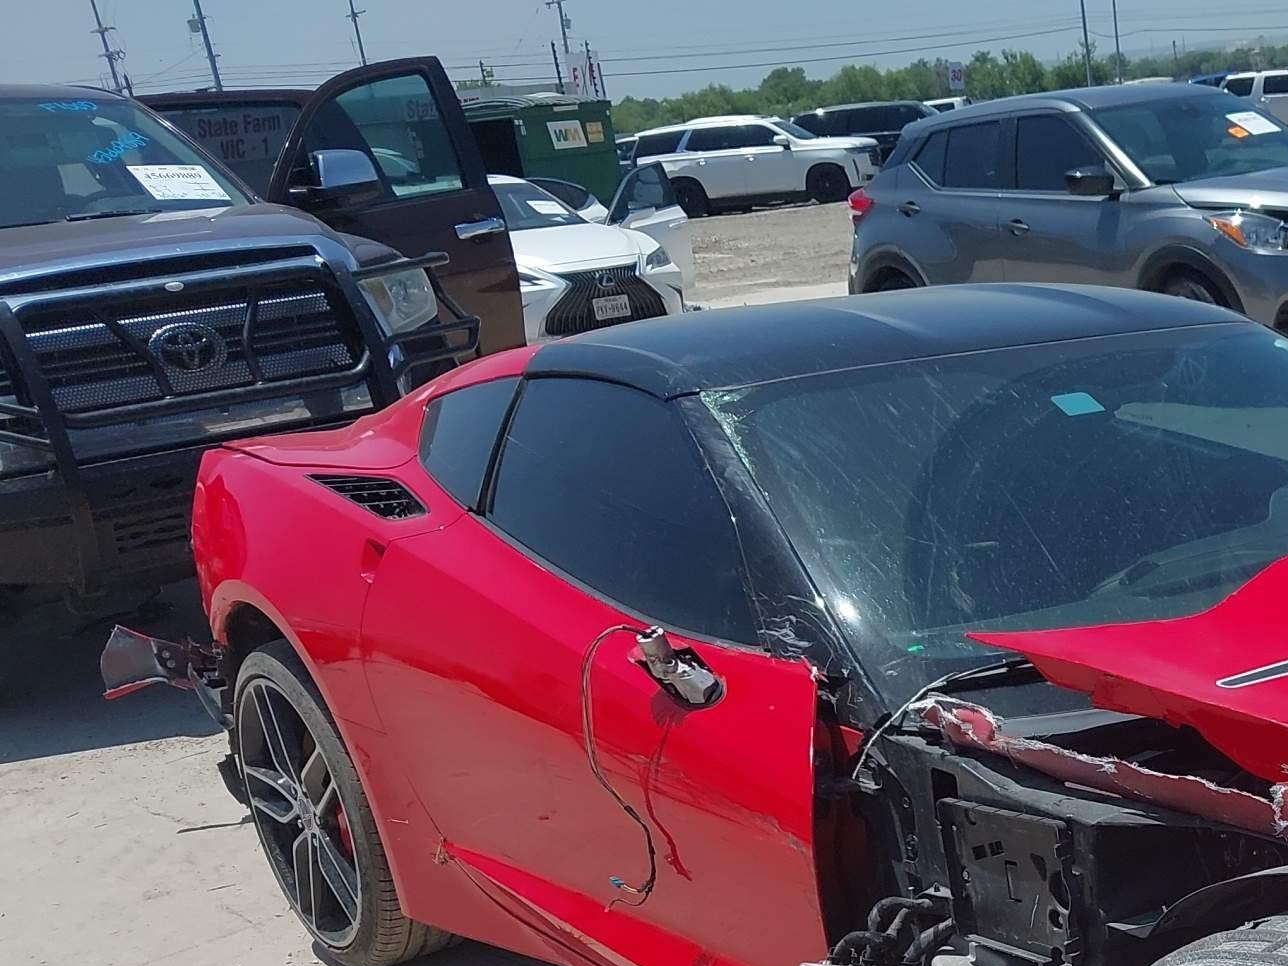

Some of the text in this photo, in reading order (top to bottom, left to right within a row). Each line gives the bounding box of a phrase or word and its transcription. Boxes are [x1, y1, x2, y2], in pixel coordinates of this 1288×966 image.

[198, 113, 282, 138] State Farm
[220, 138, 246, 161] VIC
[262, 138, 269, 155] 1
